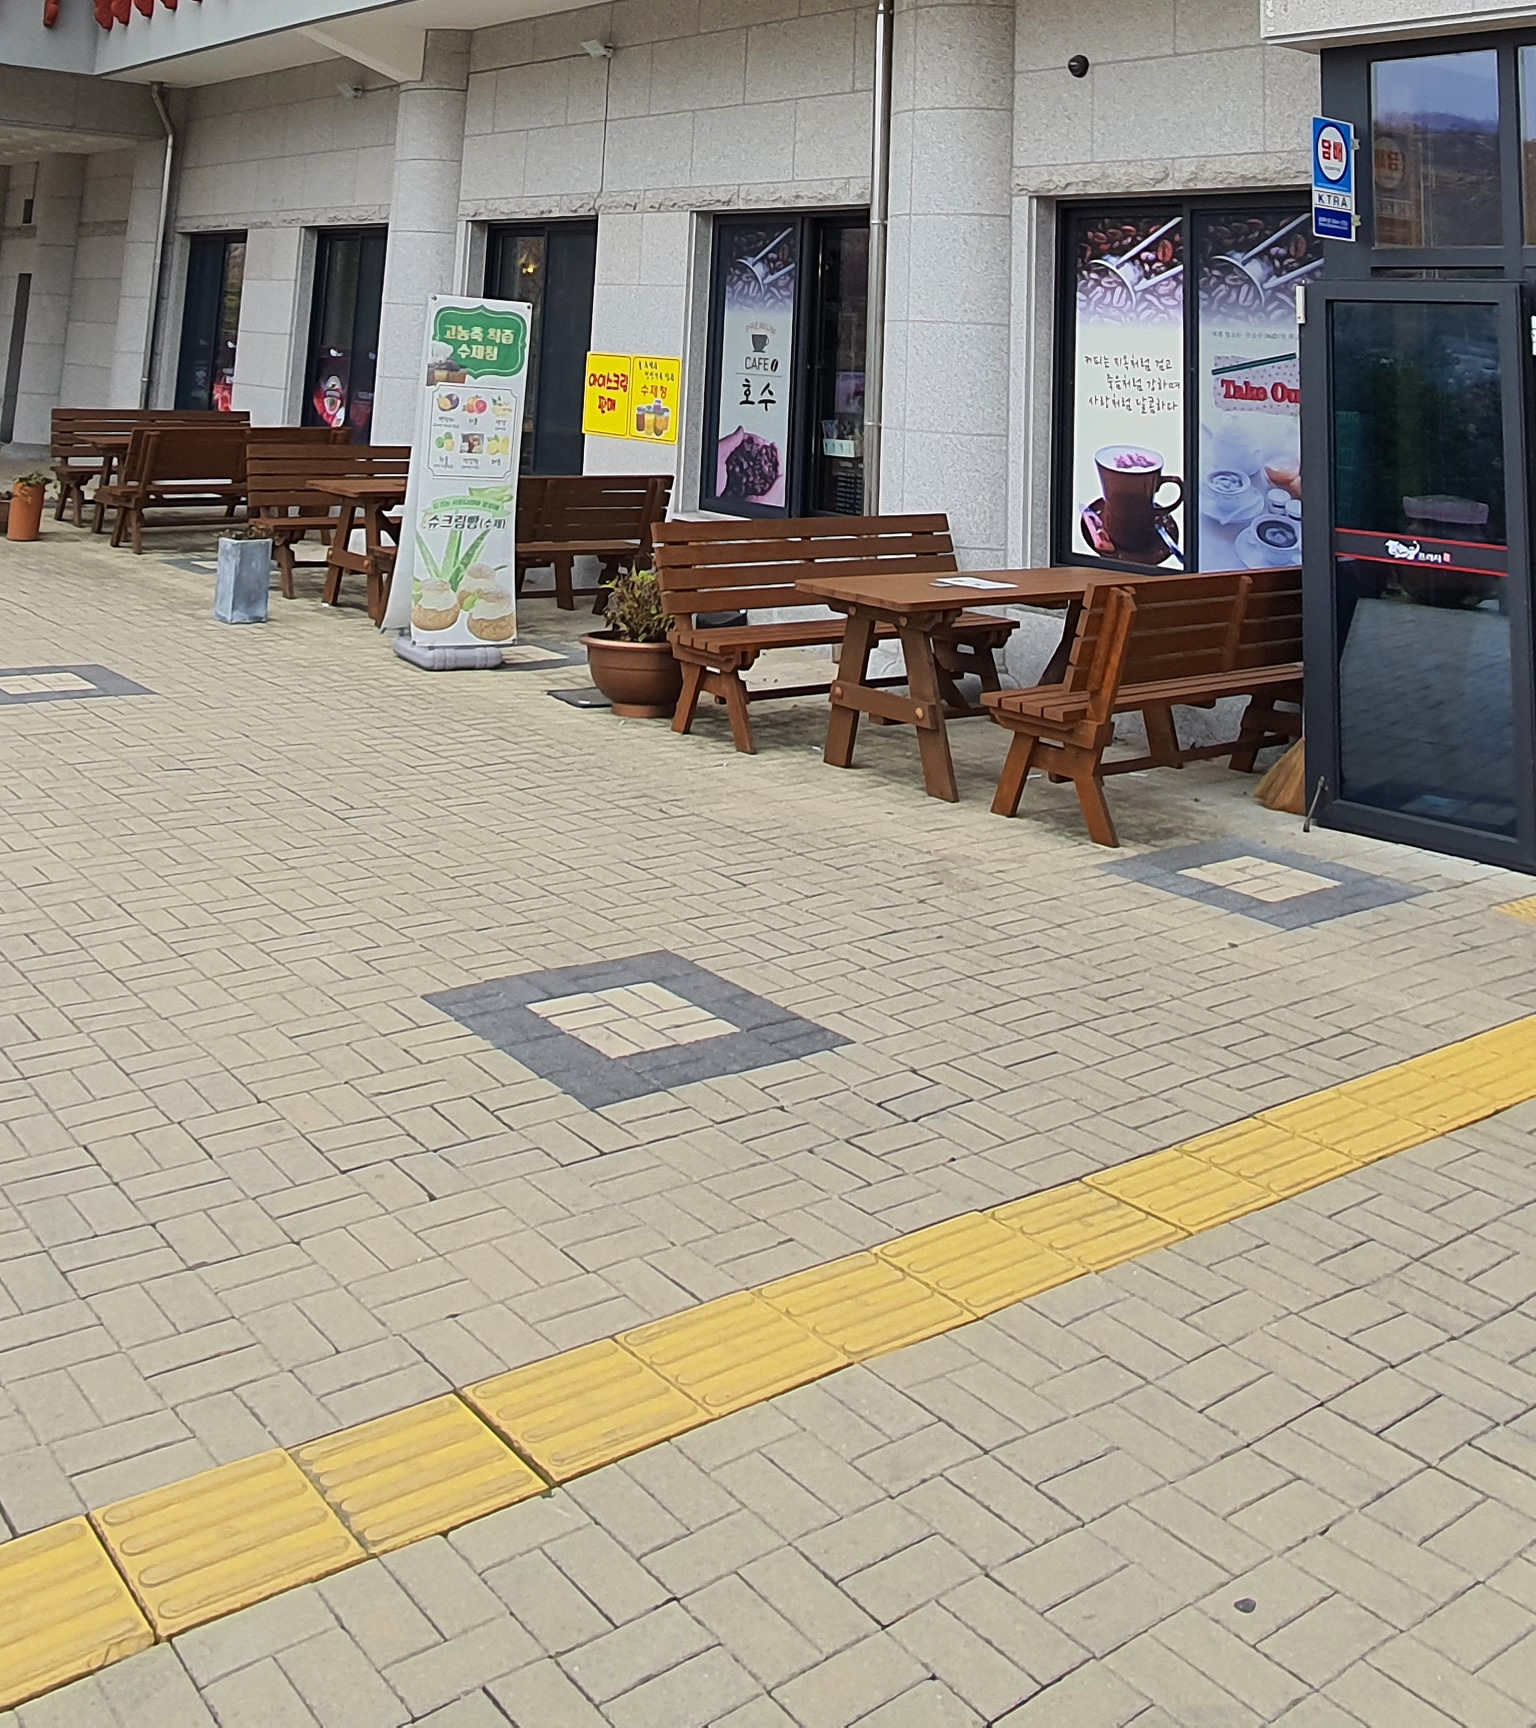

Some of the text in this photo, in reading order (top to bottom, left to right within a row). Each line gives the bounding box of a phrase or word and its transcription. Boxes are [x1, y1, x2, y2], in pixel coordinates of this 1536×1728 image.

[1321, 139, 1343, 163] 담배
[1318, 193, 1348, 208] KTRA
[444, 324, 484, 342] 고농축
[457, 343, 498, 361] 수제청
[744, 356, 770, 371] CAFE
[1084, 354, 1173, 372] 커피는 지옥처럼 검고
[588, 372, 629, 393] 아이스크림
[1106, 373, 1181, 392] 죽음처럼 강하며
[1220, 378, 1301, 404] Take Ou
[597, 394, 617, 414] 판매
[739, 377, 777, 412] 호수
[1088, 393, 1179, 415] 사랑처럼 달콤하다
